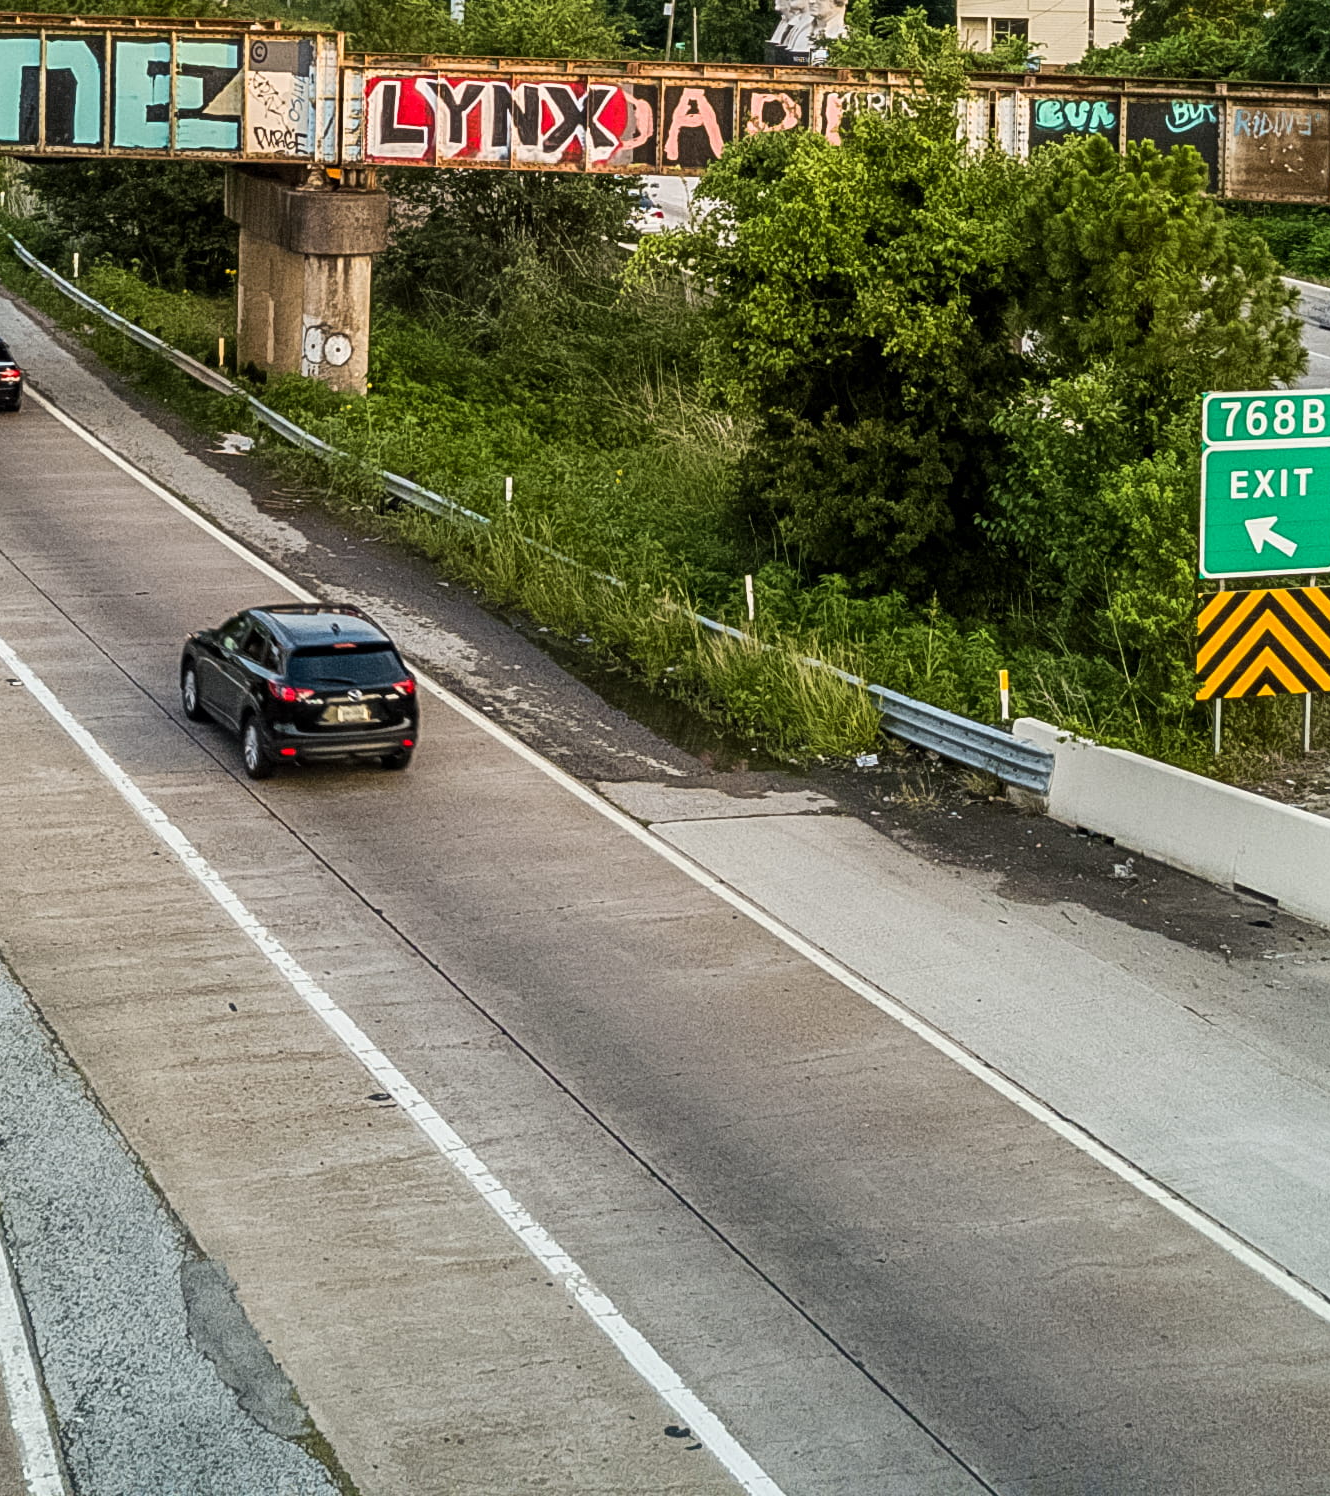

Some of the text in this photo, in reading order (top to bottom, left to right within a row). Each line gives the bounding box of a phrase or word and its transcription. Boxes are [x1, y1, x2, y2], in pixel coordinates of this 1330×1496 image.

[369, 77, 620, 163] LYNX
[253, 126, 308, 155] PURGE
[1220, 399, 1326, 437] 768B
[1230, 468, 1314, 500] EXIT
